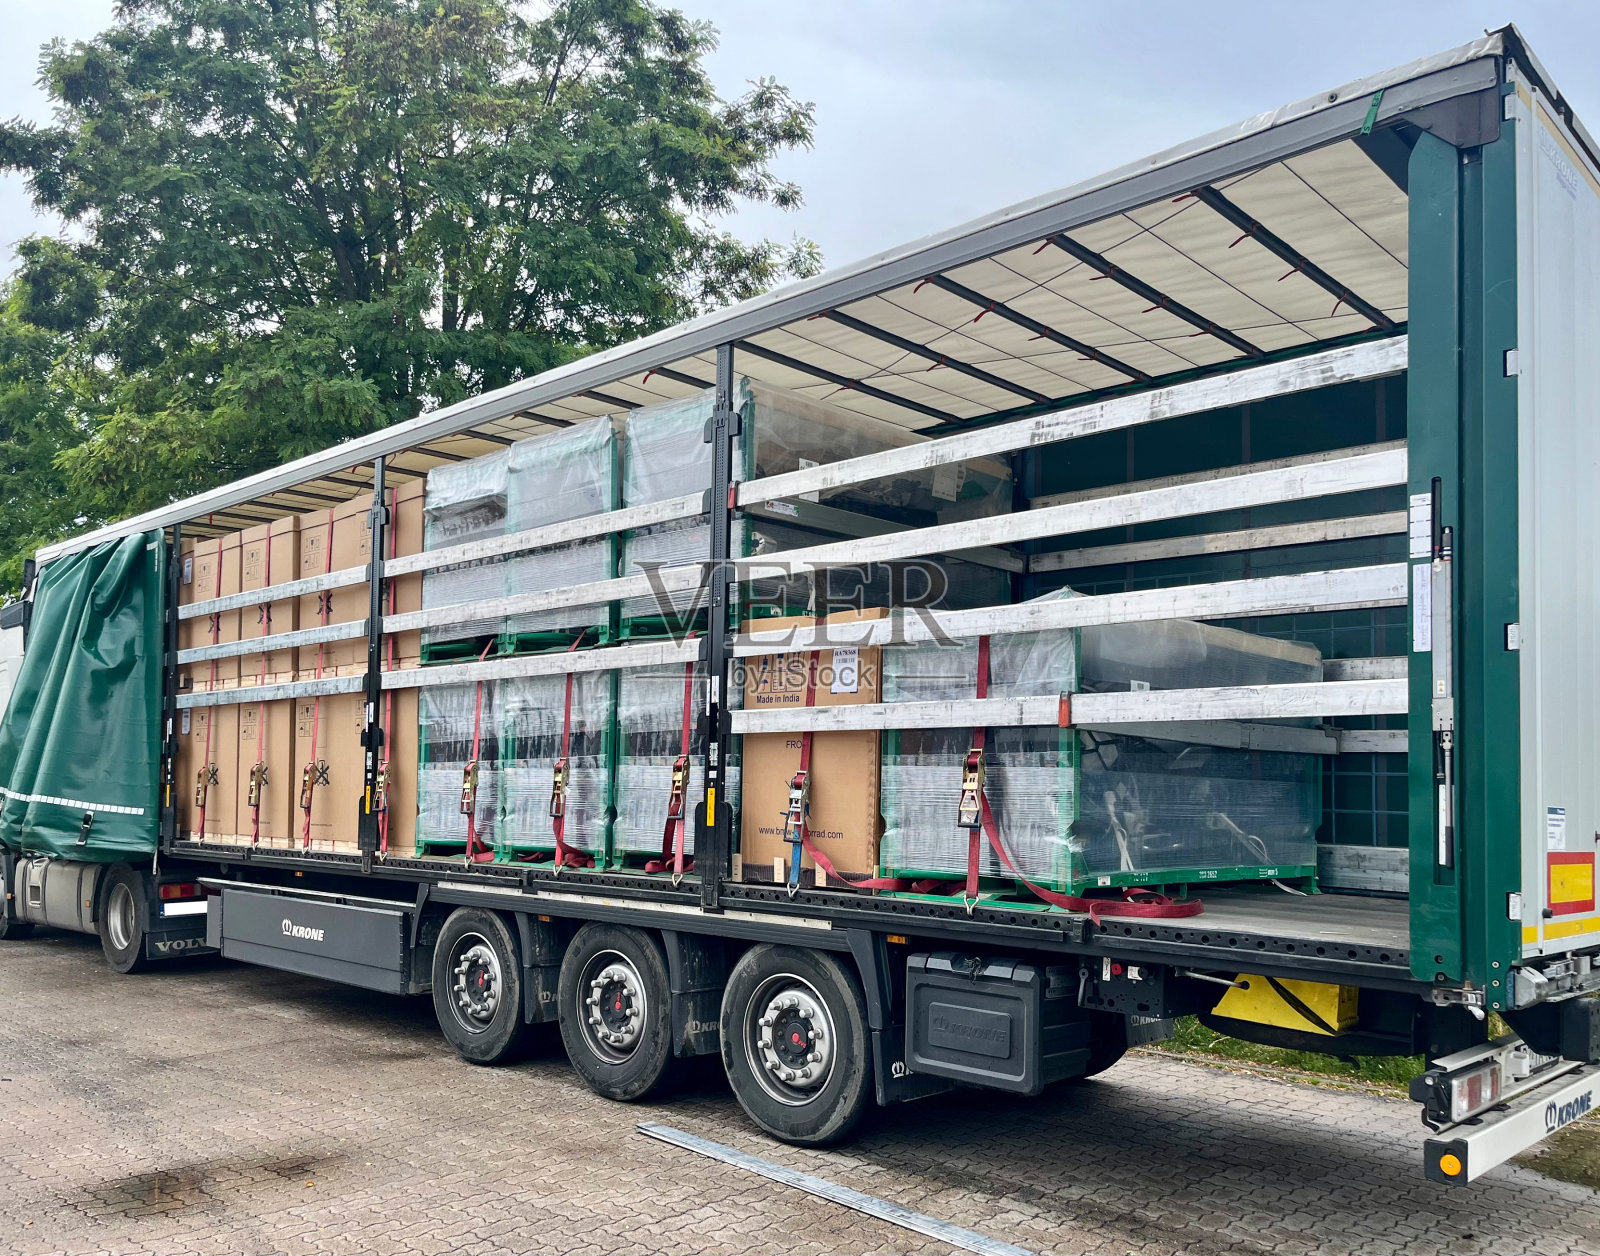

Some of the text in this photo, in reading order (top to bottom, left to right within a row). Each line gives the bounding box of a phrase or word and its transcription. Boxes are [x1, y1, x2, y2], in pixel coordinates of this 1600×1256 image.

[756, 694, 800, 704] Made in India
[785, 740, 803, 749] FRO
[292, 925, 325, 942] KRONE
[155, 938, 207, 953] VOLV
[950, 1022, 1007, 1042] KRONE
[1557, 1090, 1593, 1128] KRONE
